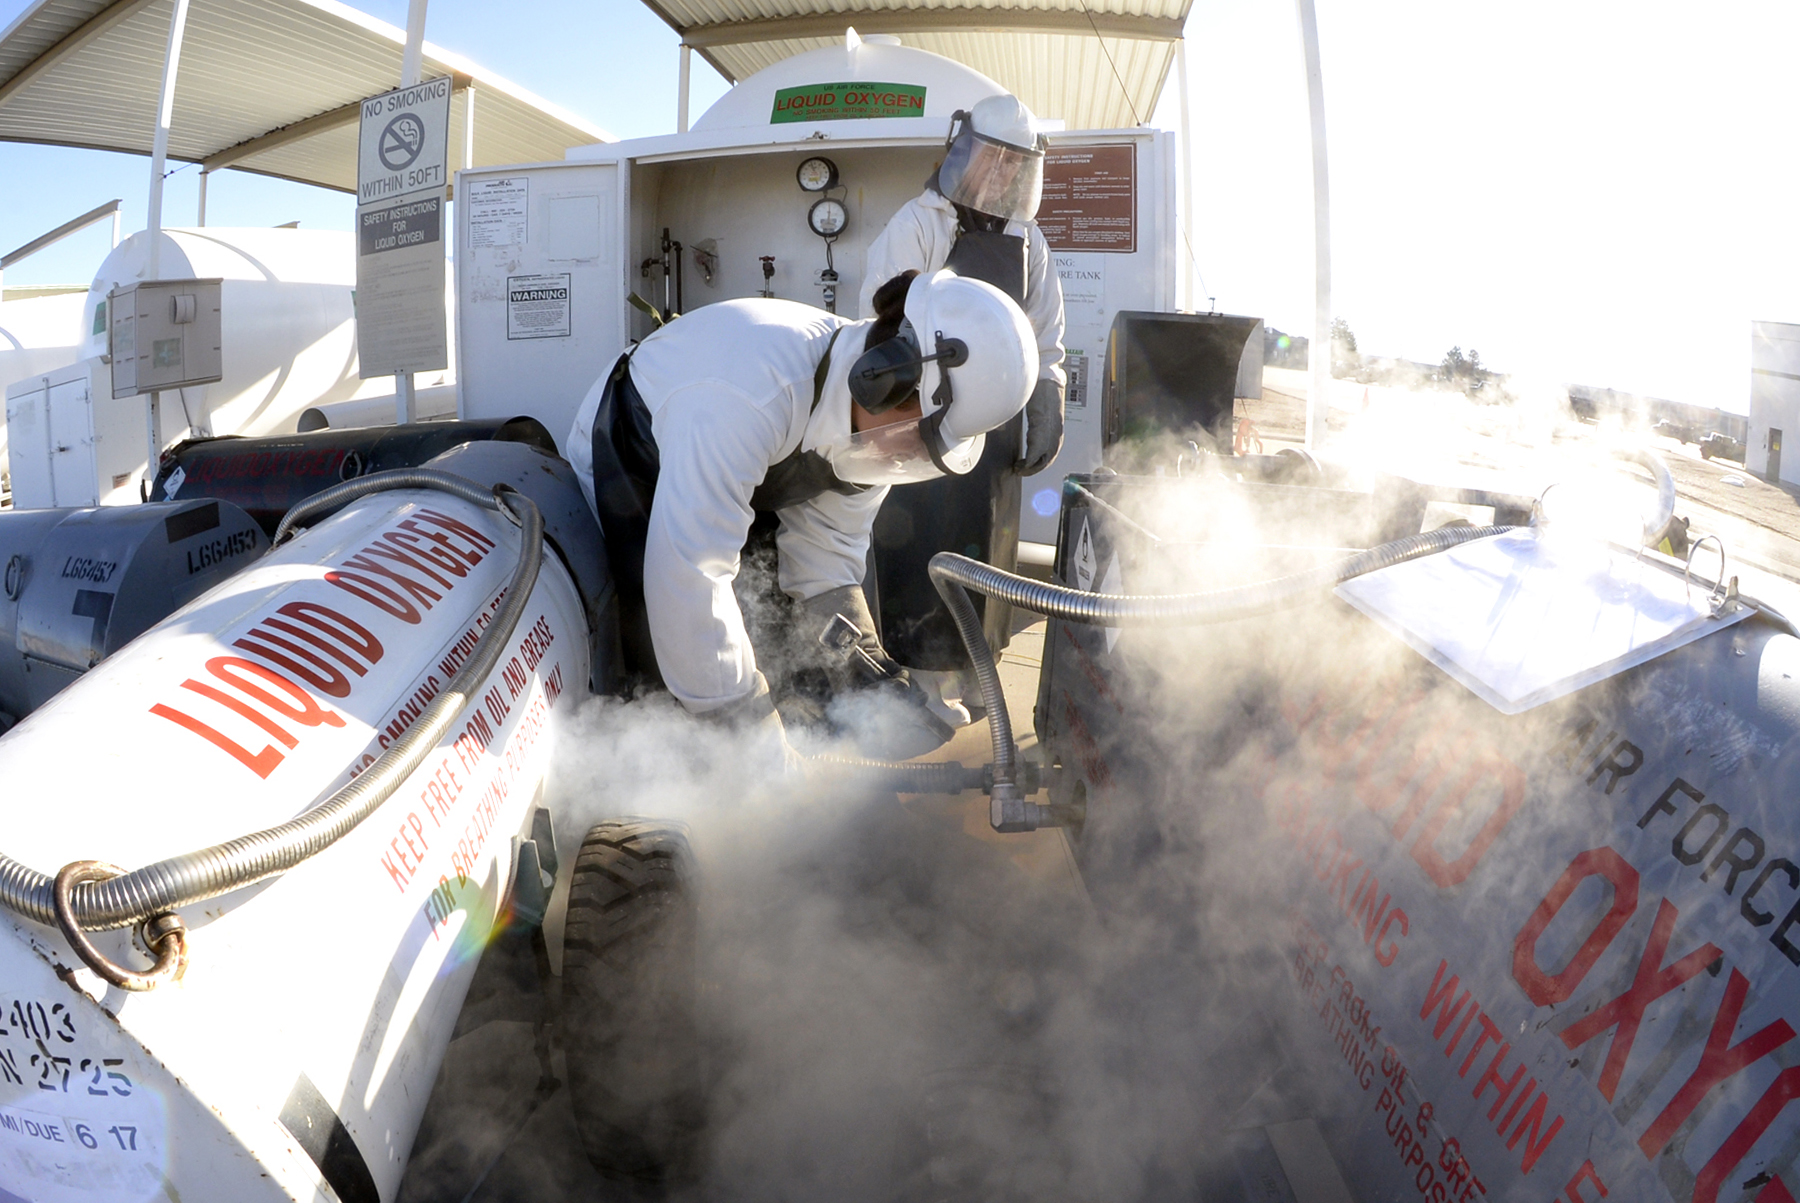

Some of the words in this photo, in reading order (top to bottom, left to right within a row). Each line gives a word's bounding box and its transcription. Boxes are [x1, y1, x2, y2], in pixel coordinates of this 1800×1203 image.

[365, 101, 382, 119] NO
[387, 82, 446, 112] SMOKING
[776, 93, 836, 111] LIQUID
[844, 92, 923, 109] OXYGEN
[362, 174, 402, 198] WITHIN
[408, 164, 440, 187] 50FT
[364, 211, 388, 226] SAFETY
[390, 200, 437, 220] INSTRUCTIONS
[392, 220, 406, 233] FOR
[375, 236, 396, 250] LIQUID
[398, 230, 424, 246] OXYGEN
[1076, 271, 1101, 280] TANK
[512, 290, 566, 301] WARNING
[61, 556, 117, 583] L66453
[187, 528, 256, 575] L66453
[148, 601, 384, 780] LIQUID
[324, 508, 496, 625] OXYGEN
[380, 811, 429, 894] KEEP
[421, 758, 464, 828] FREE
[453, 708, 494, 776] FROM
[484, 685, 511, 727] OIL
[502, 656, 527, 702] AND
[520, 614, 554, 673] GREASE
[1547, 718, 1644, 796] AIR
[423, 874, 457, 941] FOR
[451, 766, 508, 890] BREATHING
[505, 694, 547, 783] PURPOSES
[544, 661, 565, 710] ONLY
[1276, 781, 1409, 968] SMOKING
[1419, 958, 1565, 1176] WITHIN
[1294, 951, 1375, 1092] BREATHING
[1330, 964, 1382, 1051] FROM
[1381, 1045, 1407, 1106] OIL
[1416, 1101, 1434, 1139] &
[31, 1055, 132, 1097] 2725
[75, 1124, 98, 1150] 6
[108, 1126, 137, 1151] 17
